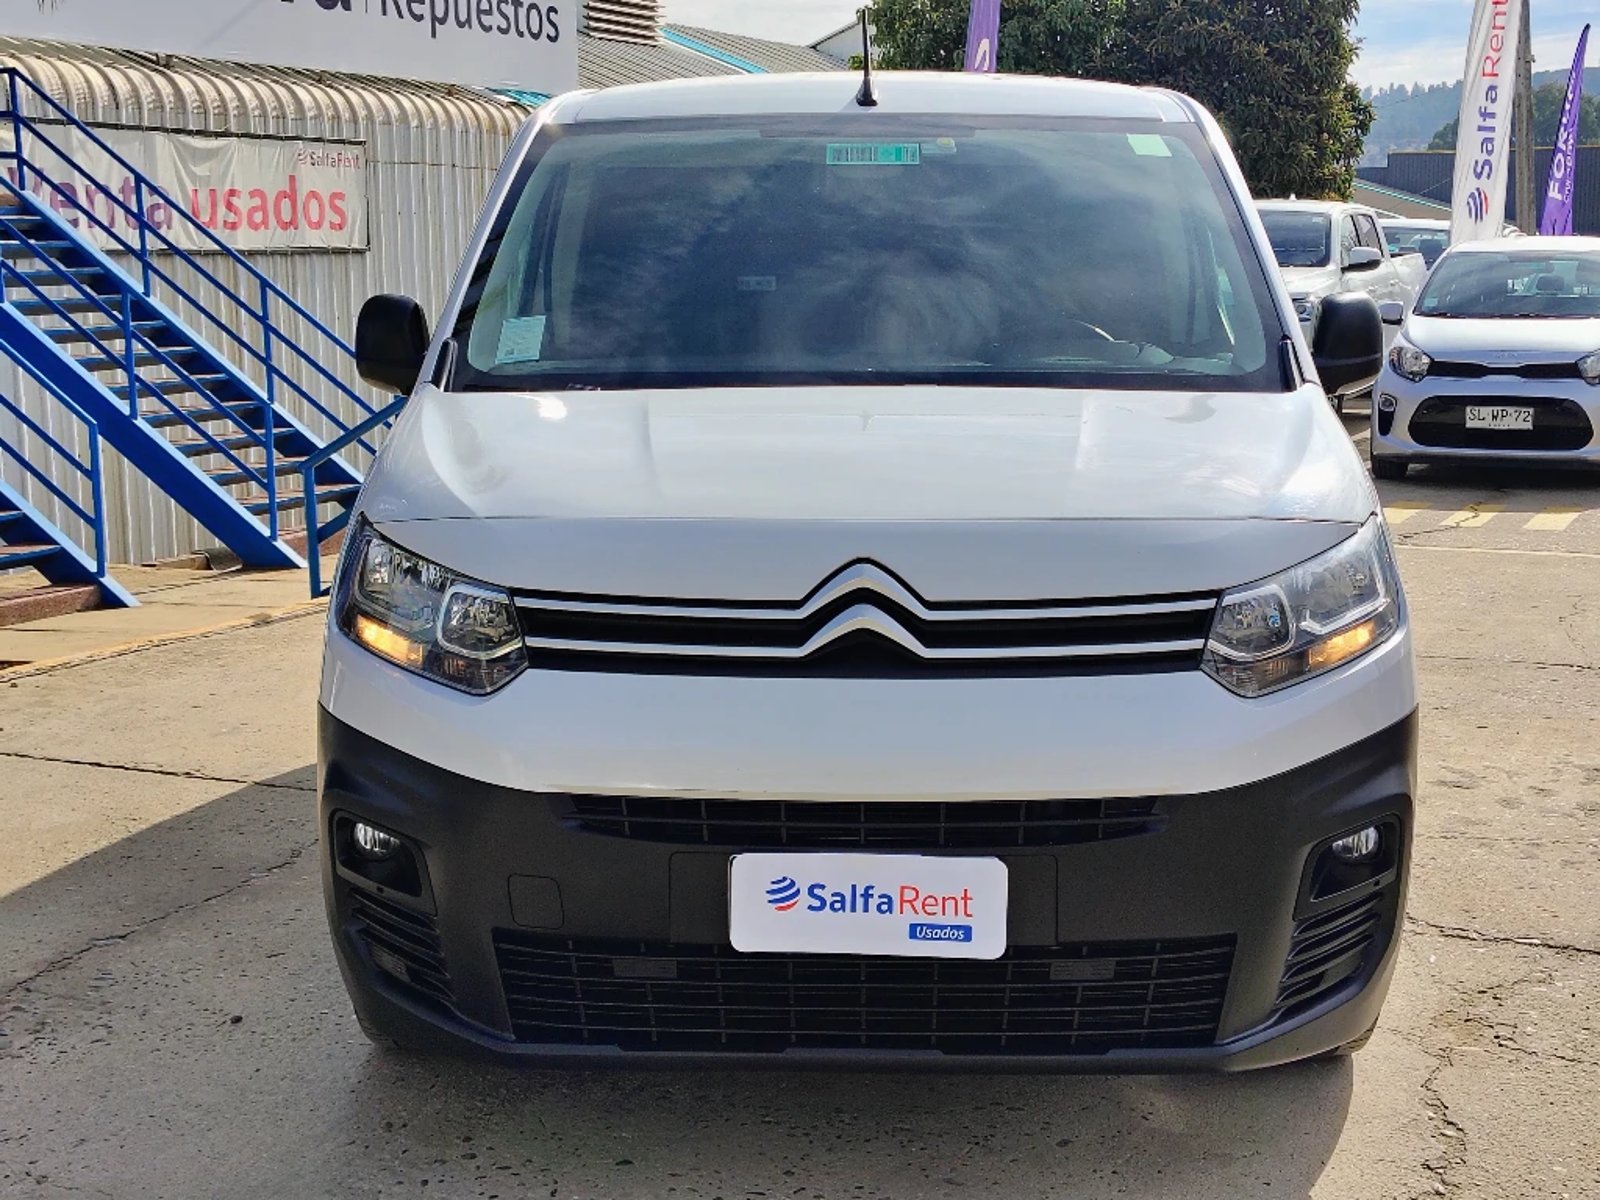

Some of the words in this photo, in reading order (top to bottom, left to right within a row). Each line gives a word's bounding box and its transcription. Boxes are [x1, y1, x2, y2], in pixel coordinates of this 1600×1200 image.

[191, 174, 348, 231] usados
[807, 883, 973, 918] SalfaRent
[916, 926, 965, 941] Usados
